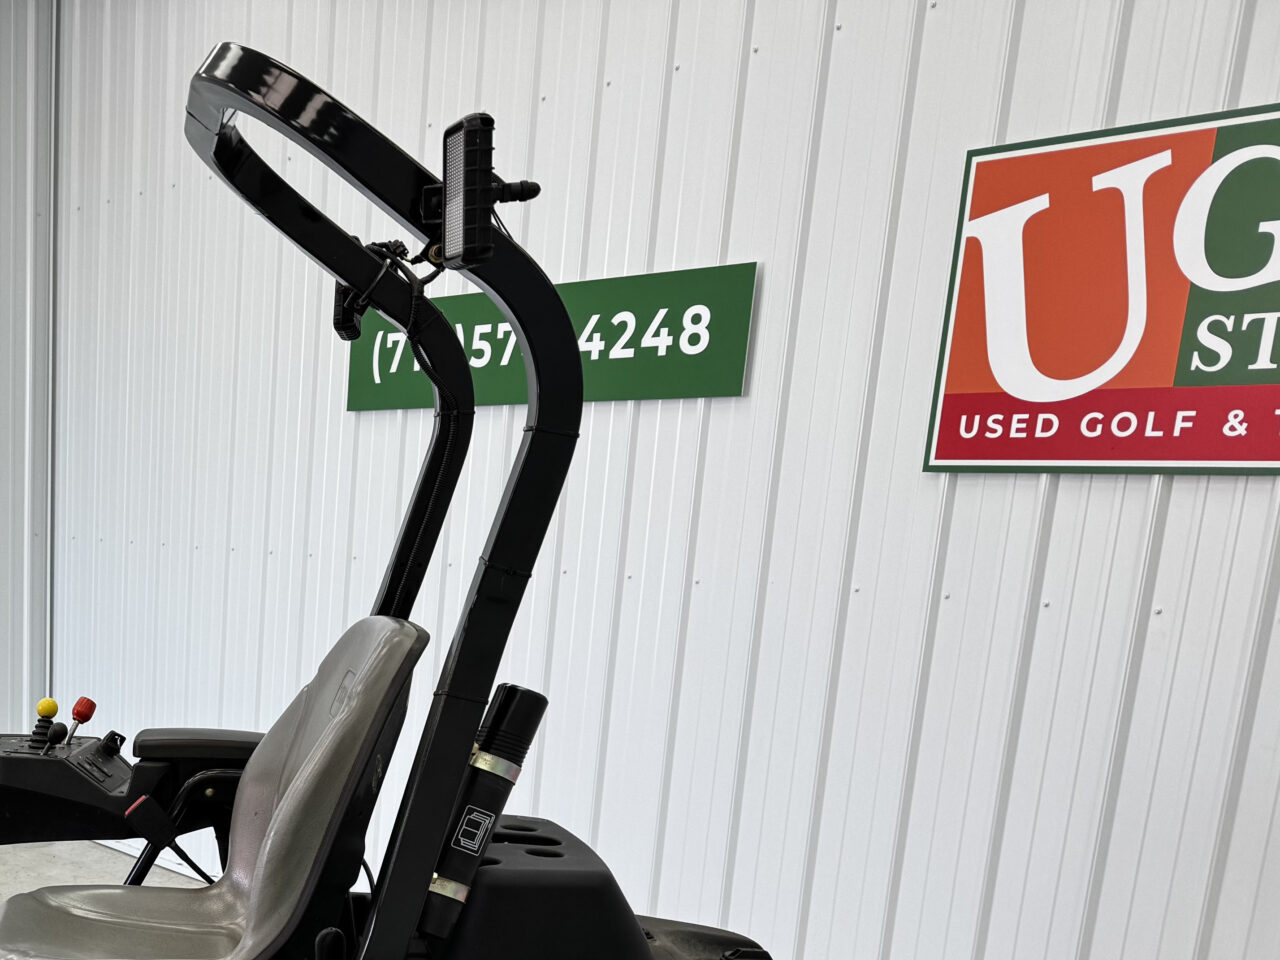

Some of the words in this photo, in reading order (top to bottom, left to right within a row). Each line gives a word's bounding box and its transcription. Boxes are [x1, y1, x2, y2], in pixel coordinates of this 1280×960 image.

[959, 413, 1060, 438] USED
[1080, 410, 1197, 438] GOLF
[1222, 409, 1248, 437] &
